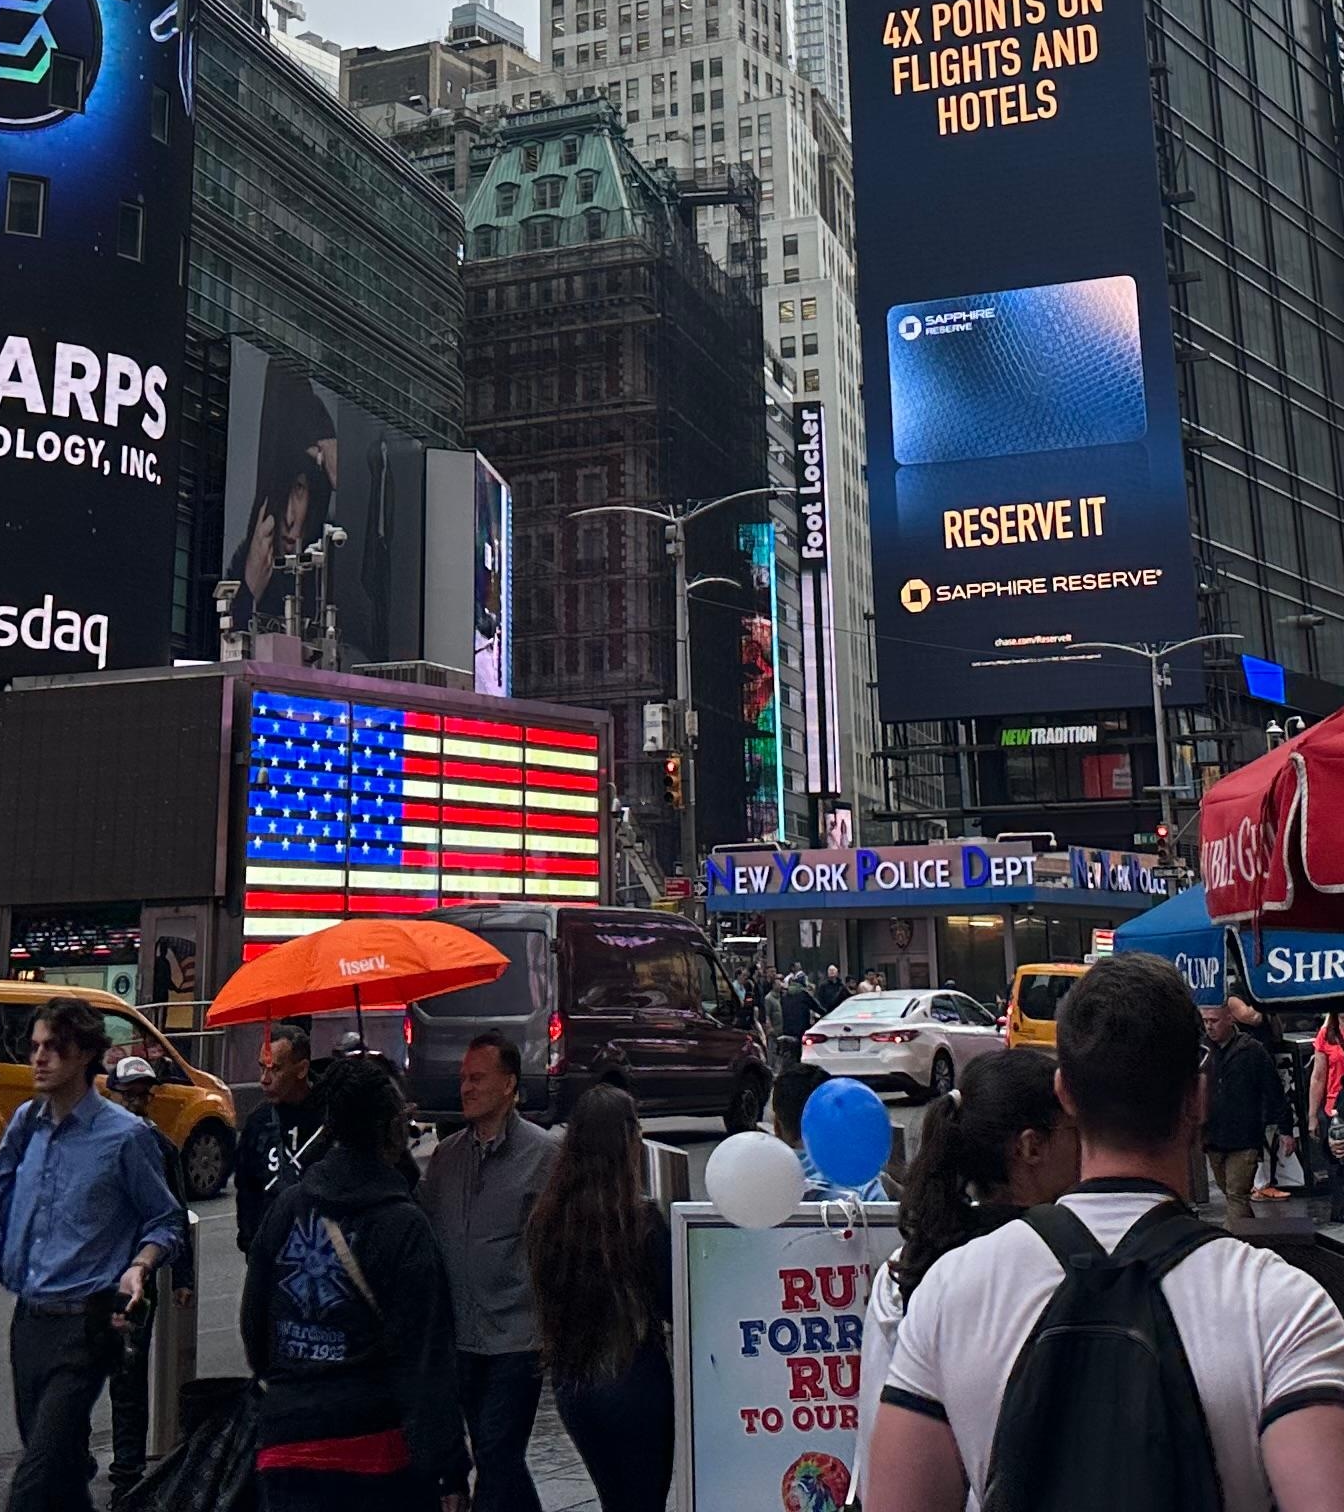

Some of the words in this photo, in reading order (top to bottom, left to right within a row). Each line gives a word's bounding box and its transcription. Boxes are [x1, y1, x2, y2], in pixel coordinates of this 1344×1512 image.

[882, 6, 924, 50] 4X
[892, 36, 1023, 96] FLIGHTS
[1031, 23, 1100, 73] AND
[937, 78, 1059, 136] HOTELS
[924, 307, 996, 326] SAPPHIRE
[924, 321, 974, 336] RESERVE
[120, 444, 162, 485] INC.
[797, 408, 821, 495] Locker
[801, 500, 824, 559] Foot
[943, 499, 1074, 550] RESERVE
[1078, 495, 1107, 538] IT
[936, 577, 1048, 603] SAPPHIRE
[705, 853, 772, 897] NEW
[772, 851, 849, 895] YORK
[855, 848, 952, 891] POLICE
[961, 844, 1038, 889] DEPT
[1069, 846, 1103, 889] NEW
[1102, 851, 1133, 892] YORK
[338, 953, 391, 978] fiserv.
[1174, 951, 1220, 990] GUMP
[778, 1263, 871, 1312] RU
[740, 1406, 784, 1435] TO
[792, 1403, 860, 1433] OUR
